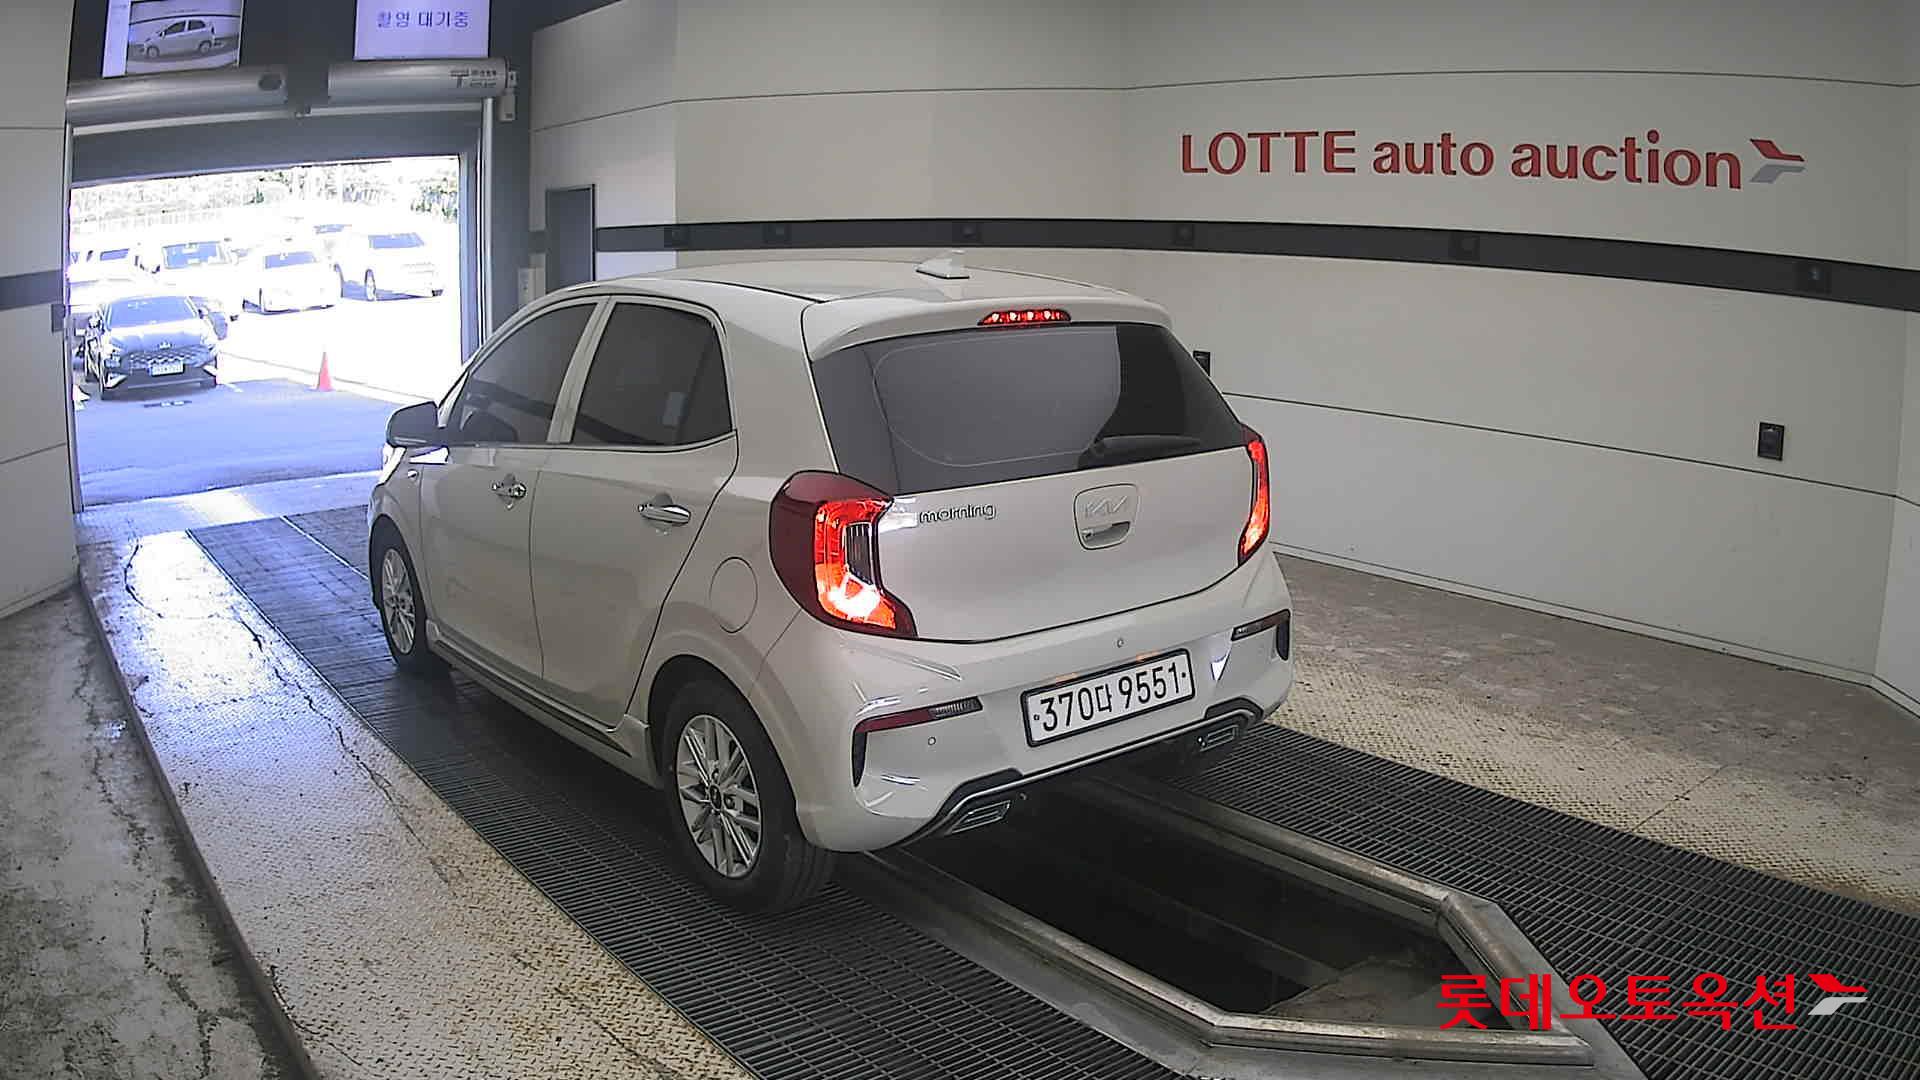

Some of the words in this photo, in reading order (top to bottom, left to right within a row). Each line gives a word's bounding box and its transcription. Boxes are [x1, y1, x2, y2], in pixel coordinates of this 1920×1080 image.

[418, 11, 468, 28] 대기중
[1181, 130, 1356, 175] LOTTE
[1372, 132, 1495, 177] auto
[1510, 129, 1741, 190] auction
[919, 503, 997, 523] morning
[1040, 683, 1113, 732] 370다
[1118, 661, 1181, 710] 9551
